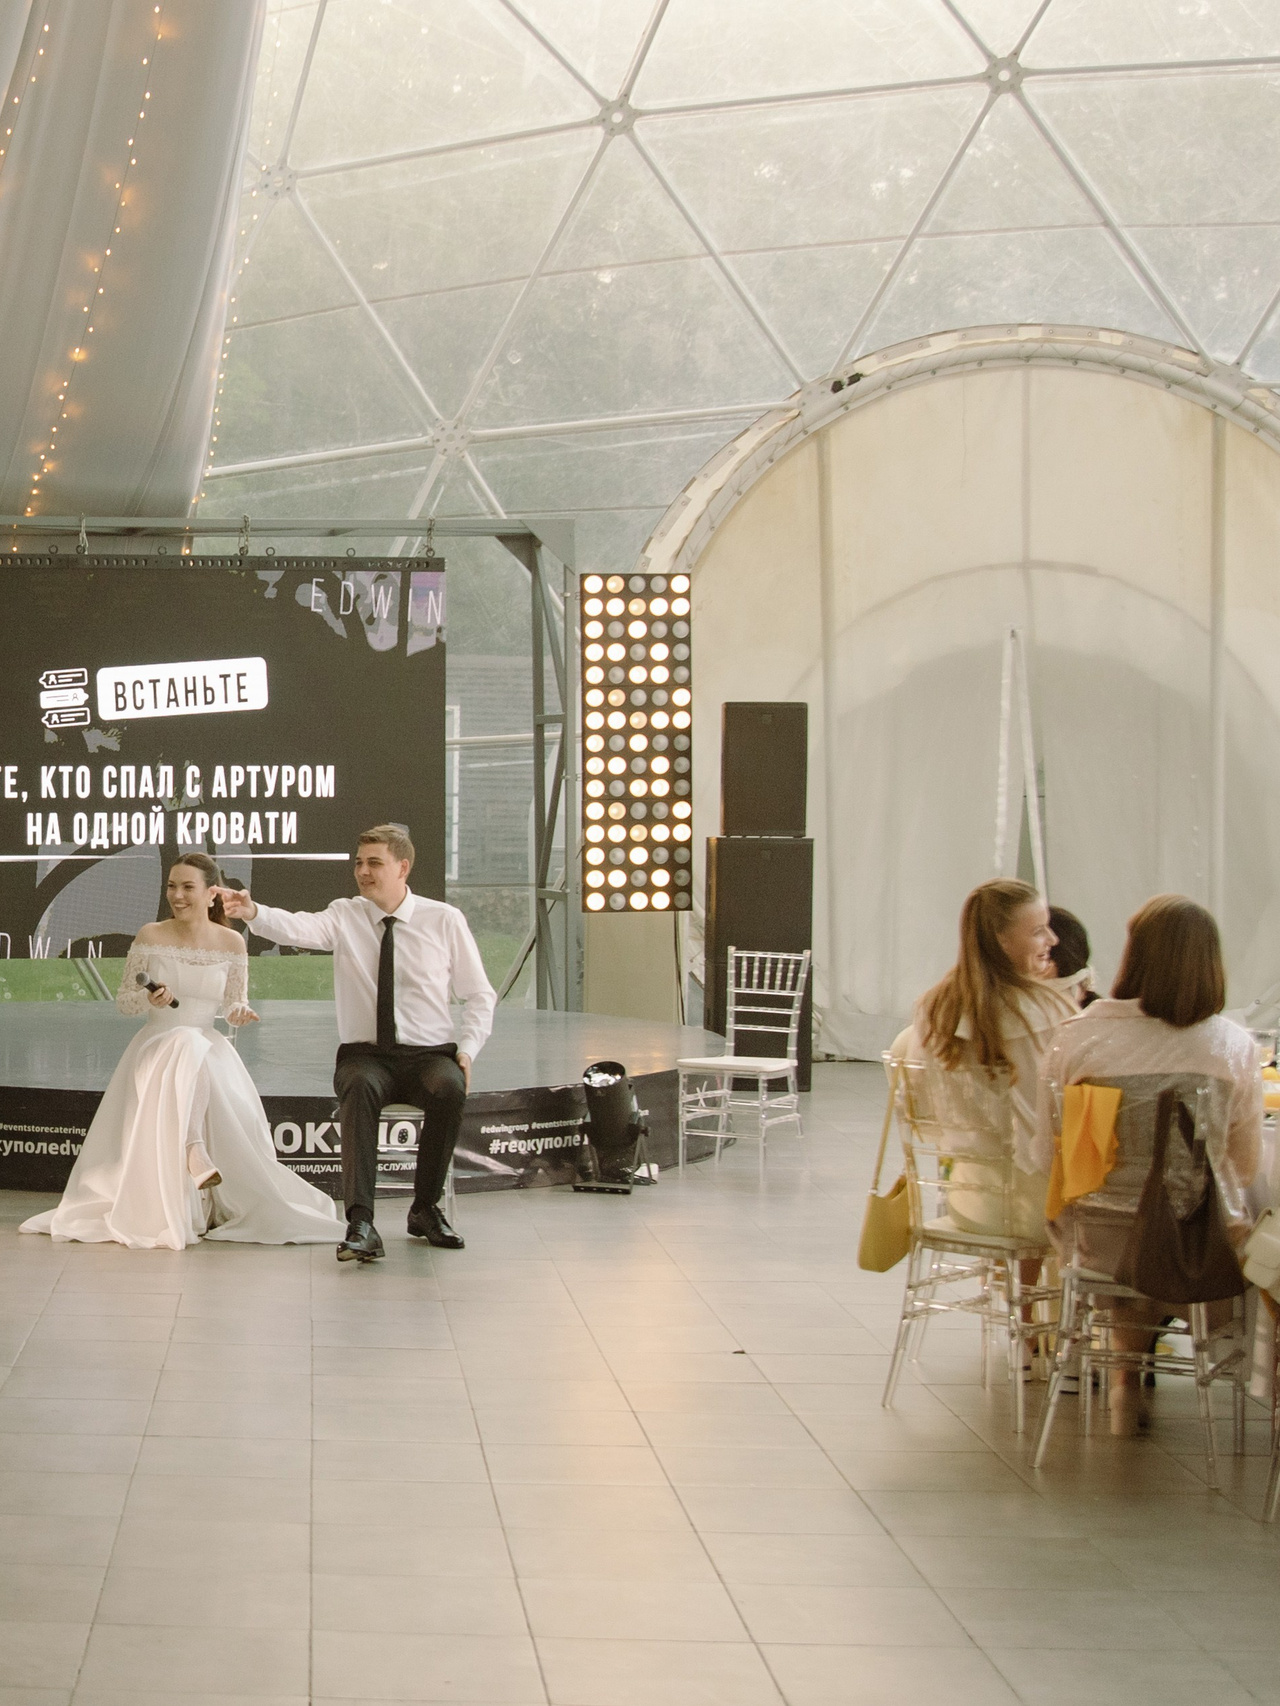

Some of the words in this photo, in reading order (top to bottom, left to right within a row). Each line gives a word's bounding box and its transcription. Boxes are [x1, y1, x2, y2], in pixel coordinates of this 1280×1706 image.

[310, 577, 443, 625] EDWIN
[113, 672, 249, 712] ВСТАНЬТЕ
[40, 764, 91, 799] КТО
[102, 764, 174, 799] СПАЛ
[185, 764, 201, 799] С
[211, 764, 336, 798] АРТУРОМ
[26, 812, 62, 846] НА
[72, 804, 165, 850] ОДНОЙ
[176, 811, 298, 846] КРОВАТИ
[480, 1123, 530, 1135] #edwingroup
